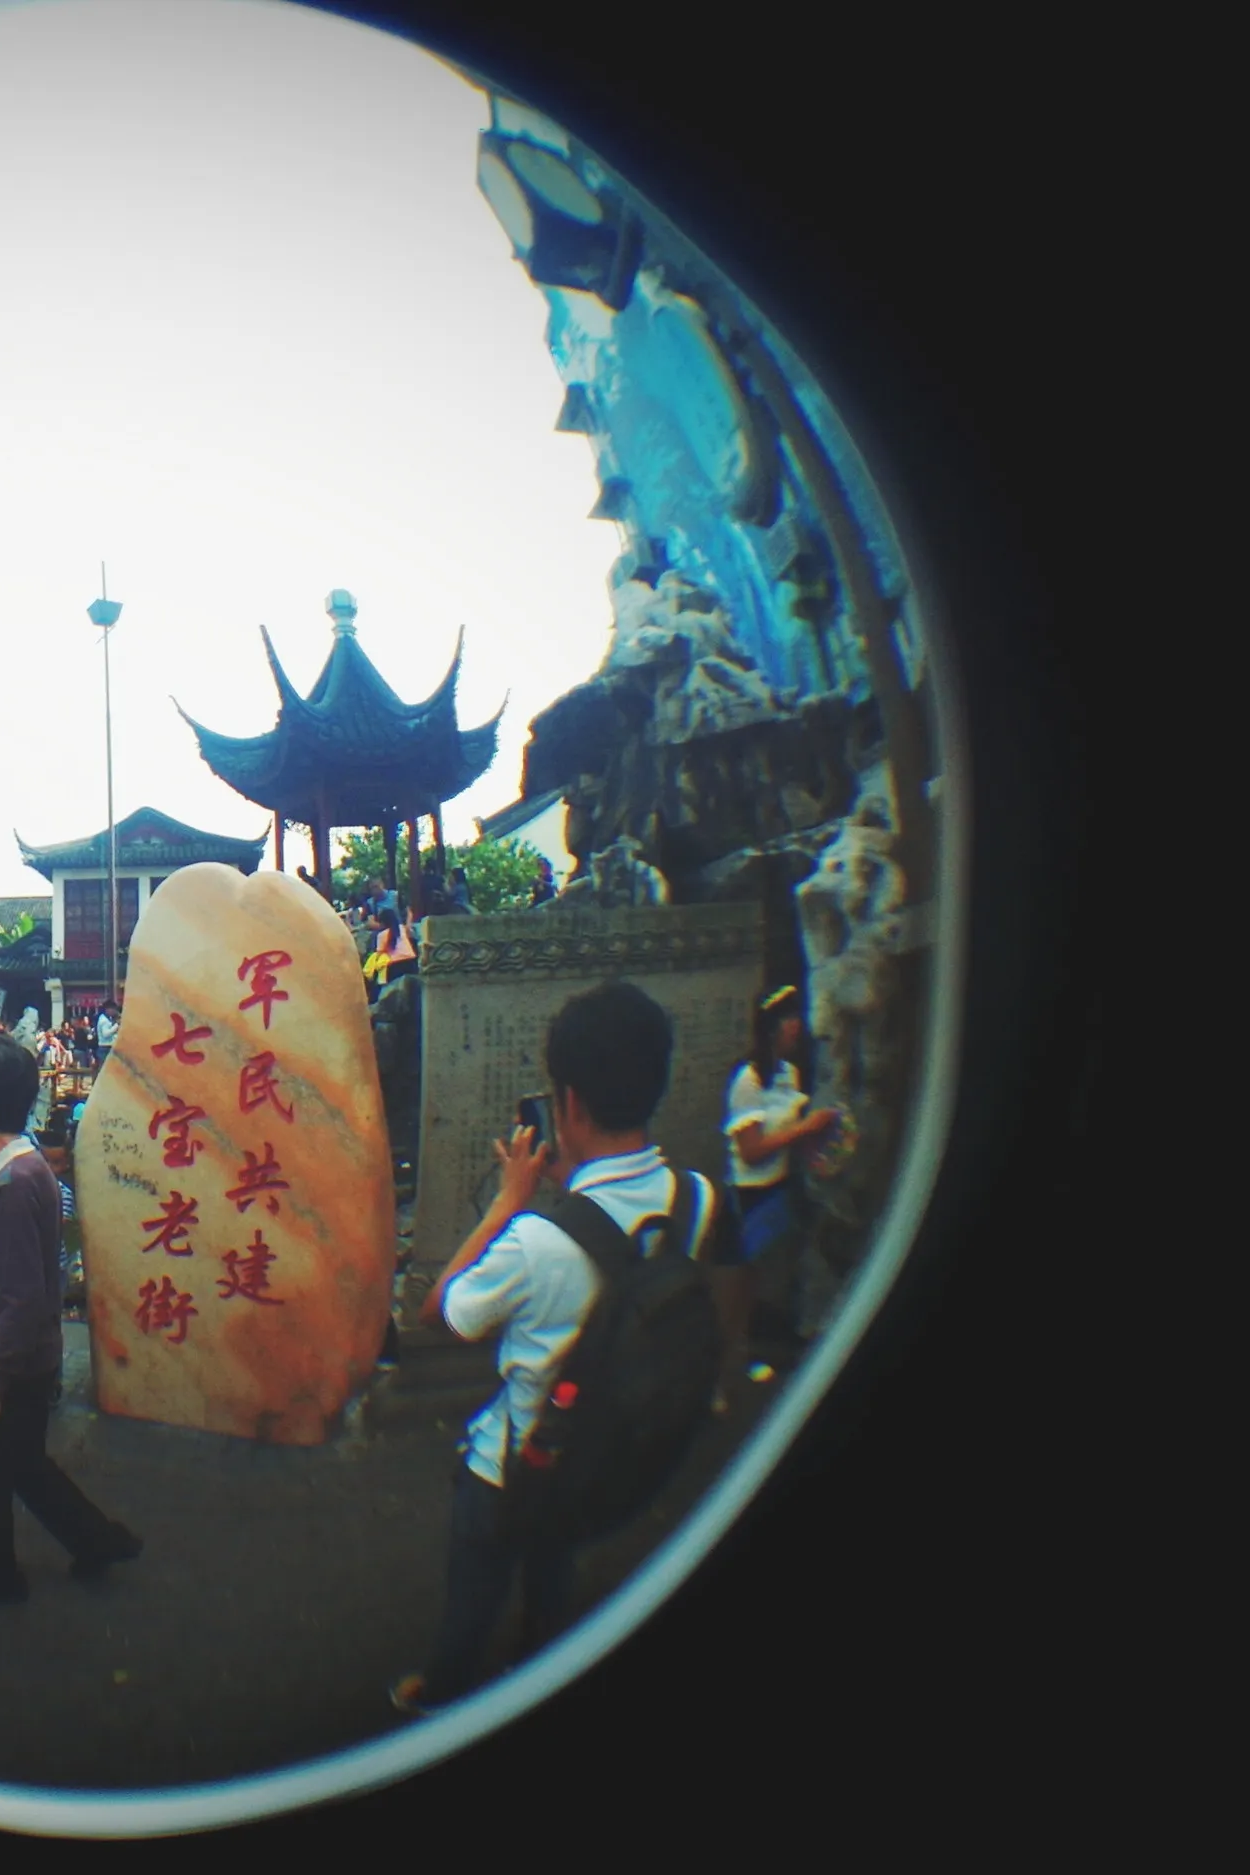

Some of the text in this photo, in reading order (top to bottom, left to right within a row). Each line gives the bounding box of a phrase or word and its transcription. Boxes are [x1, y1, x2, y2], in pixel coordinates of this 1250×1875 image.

[135, 1012, 212, 1345] 七宝老街
[217, 949, 296, 1306] 军民共建
